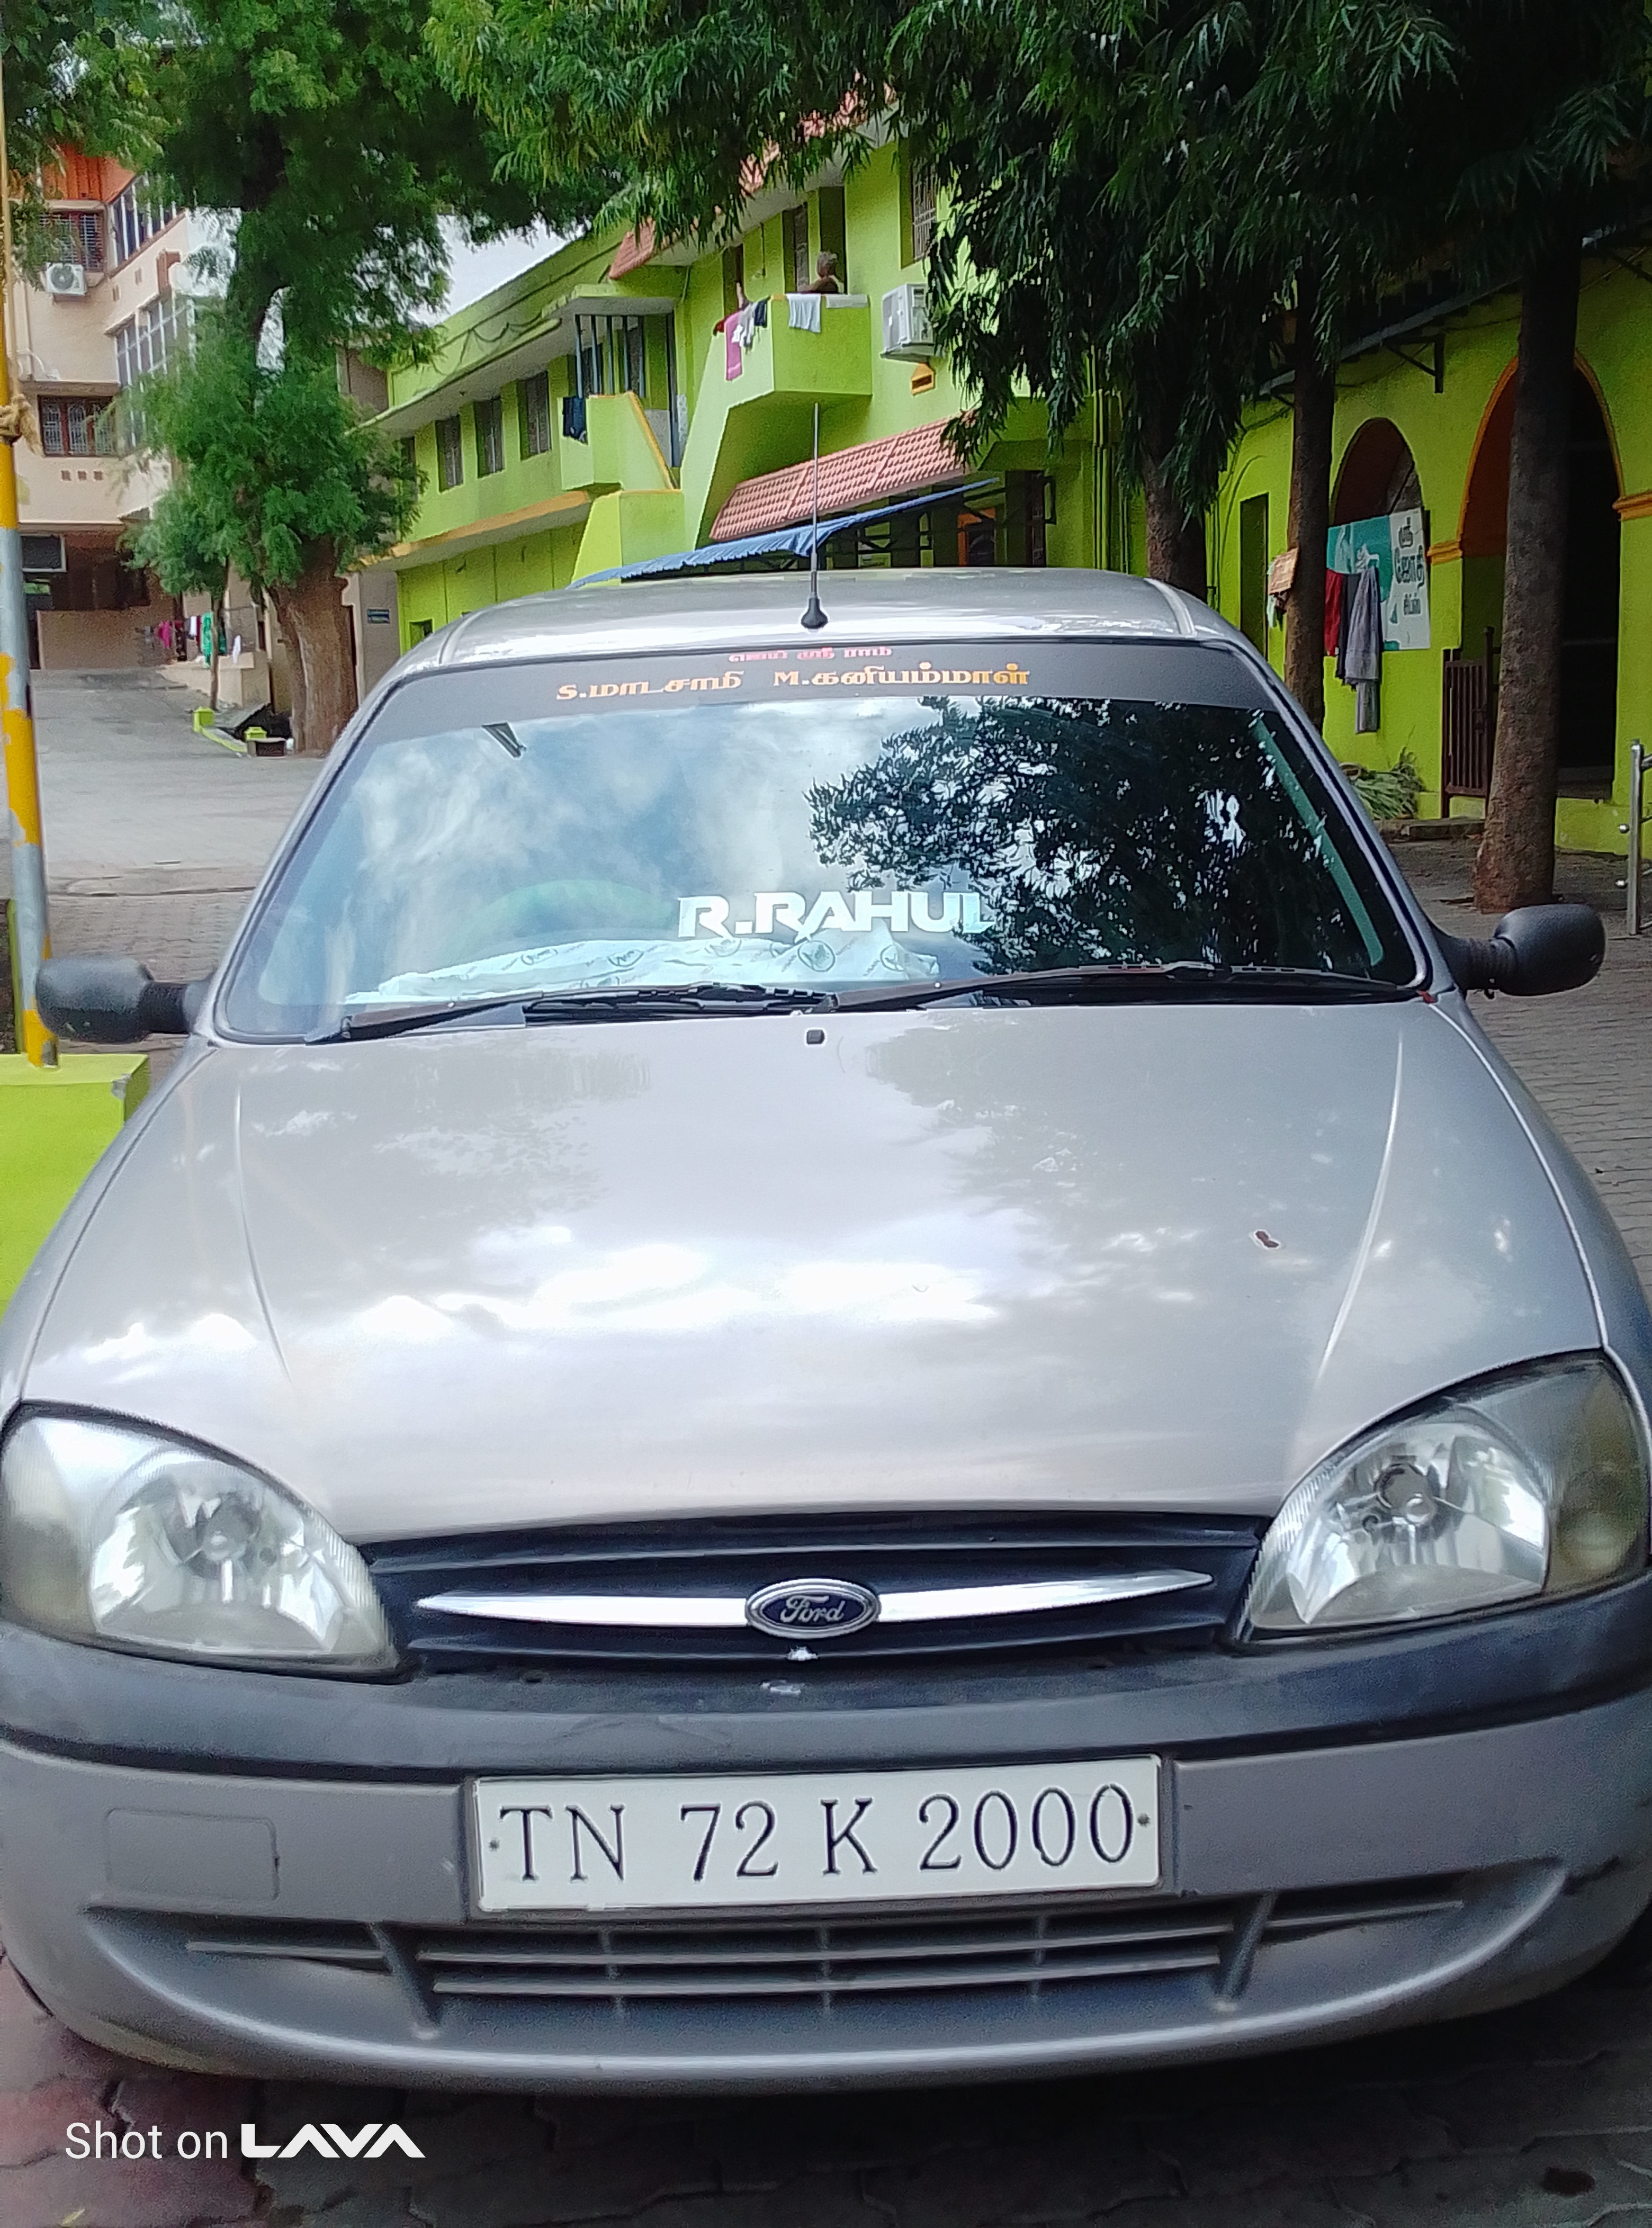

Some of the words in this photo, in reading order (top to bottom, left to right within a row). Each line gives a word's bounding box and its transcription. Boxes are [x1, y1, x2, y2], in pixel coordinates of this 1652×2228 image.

[678, 891, 995, 944] R.RAHUL
[780, 1594, 845, 1623] Ford
[499, 1803, 626, 1883] TN
[680, 1800, 779, 1882] 72
[820, 1798, 877, 1876] K
[918, 1783, 1135, 1872] 2000
